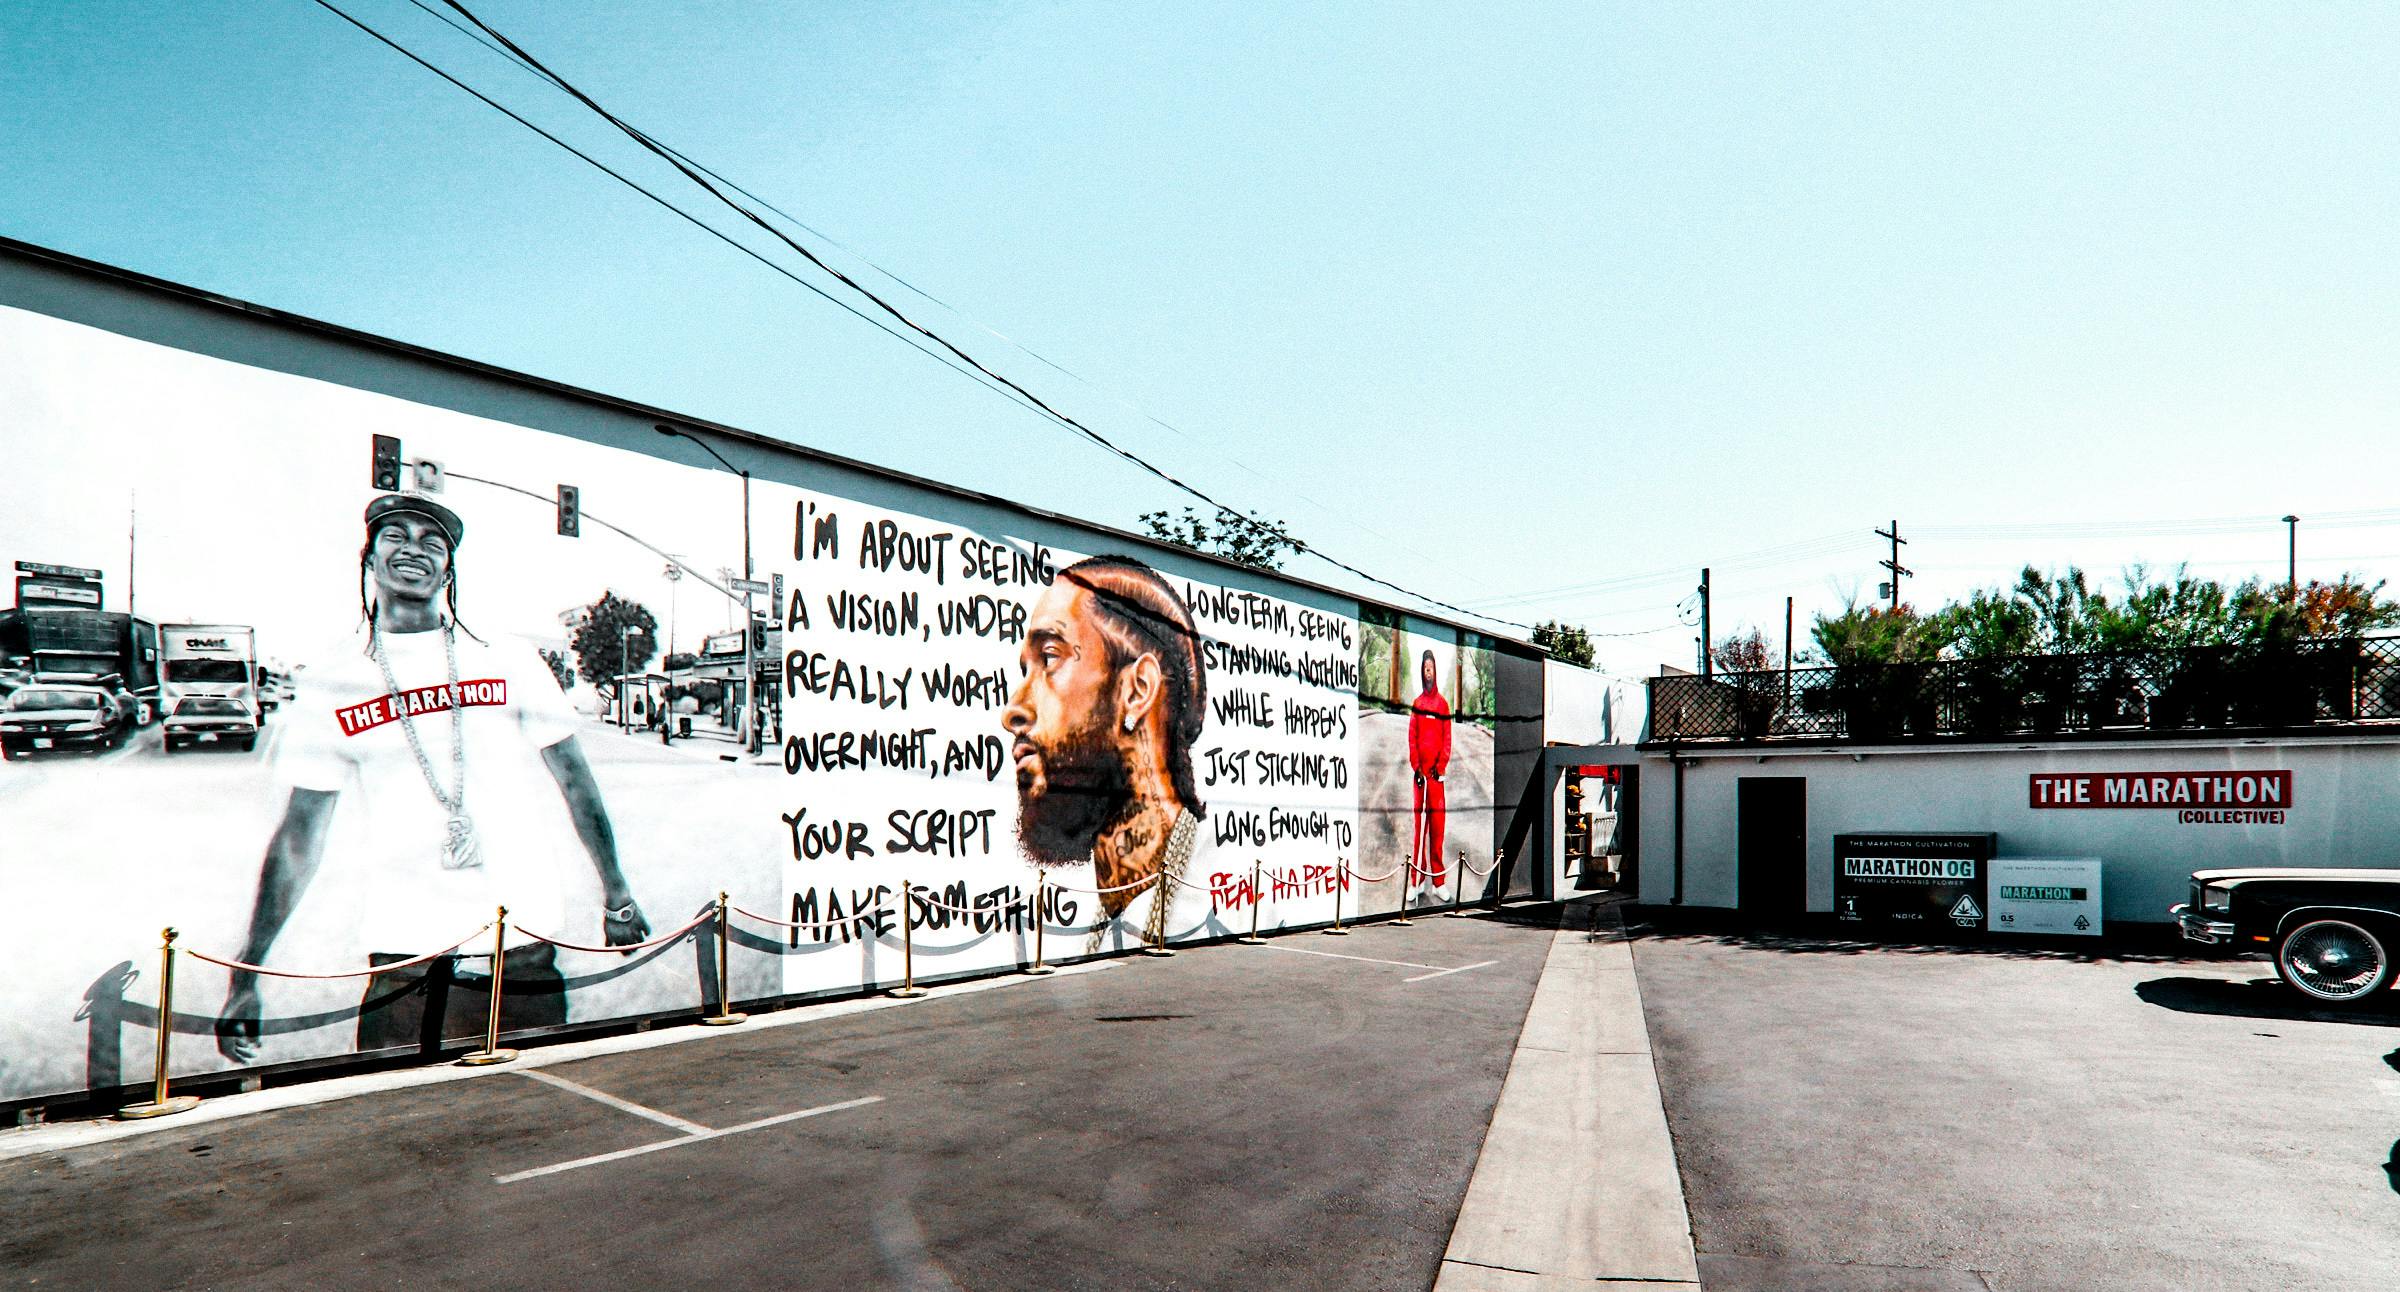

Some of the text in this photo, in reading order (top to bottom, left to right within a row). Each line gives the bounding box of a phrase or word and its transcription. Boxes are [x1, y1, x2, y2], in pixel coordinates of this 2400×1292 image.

[794, 500, 838, 561] I'M
[860, 519, 953, 585] ABOUT
[960, 537, 1054, 586] SEEING
[1299, 610, 1351, 650] SEEING
[788, 588, 1357, 689] A VISION, UNDER STANDING NOTHING
[786, 650, 1346, 739] REALLY WORTH WHILE HAPPENS
[340, 702, 384, 731] THE
[785, 728, 1347, 789] OVERNIGHT, AND JUST STICKING TO
[2035, 777, 2281, 803] THE MARATHON
[782, 807, 1351, 860] YOUR SCRIPT LONG ENOUGH TO
[2178, 810, 2286, 824] (COLLECTIVE)
[1847, 859, 1972, 877] MARATHON OG
[790, 859, 1349, 948] MAKE SOMETHING REAL HAPPEN
[1846, 900, 1854, 911] 1
[2002, 886, 2071, 899] MARATHON
